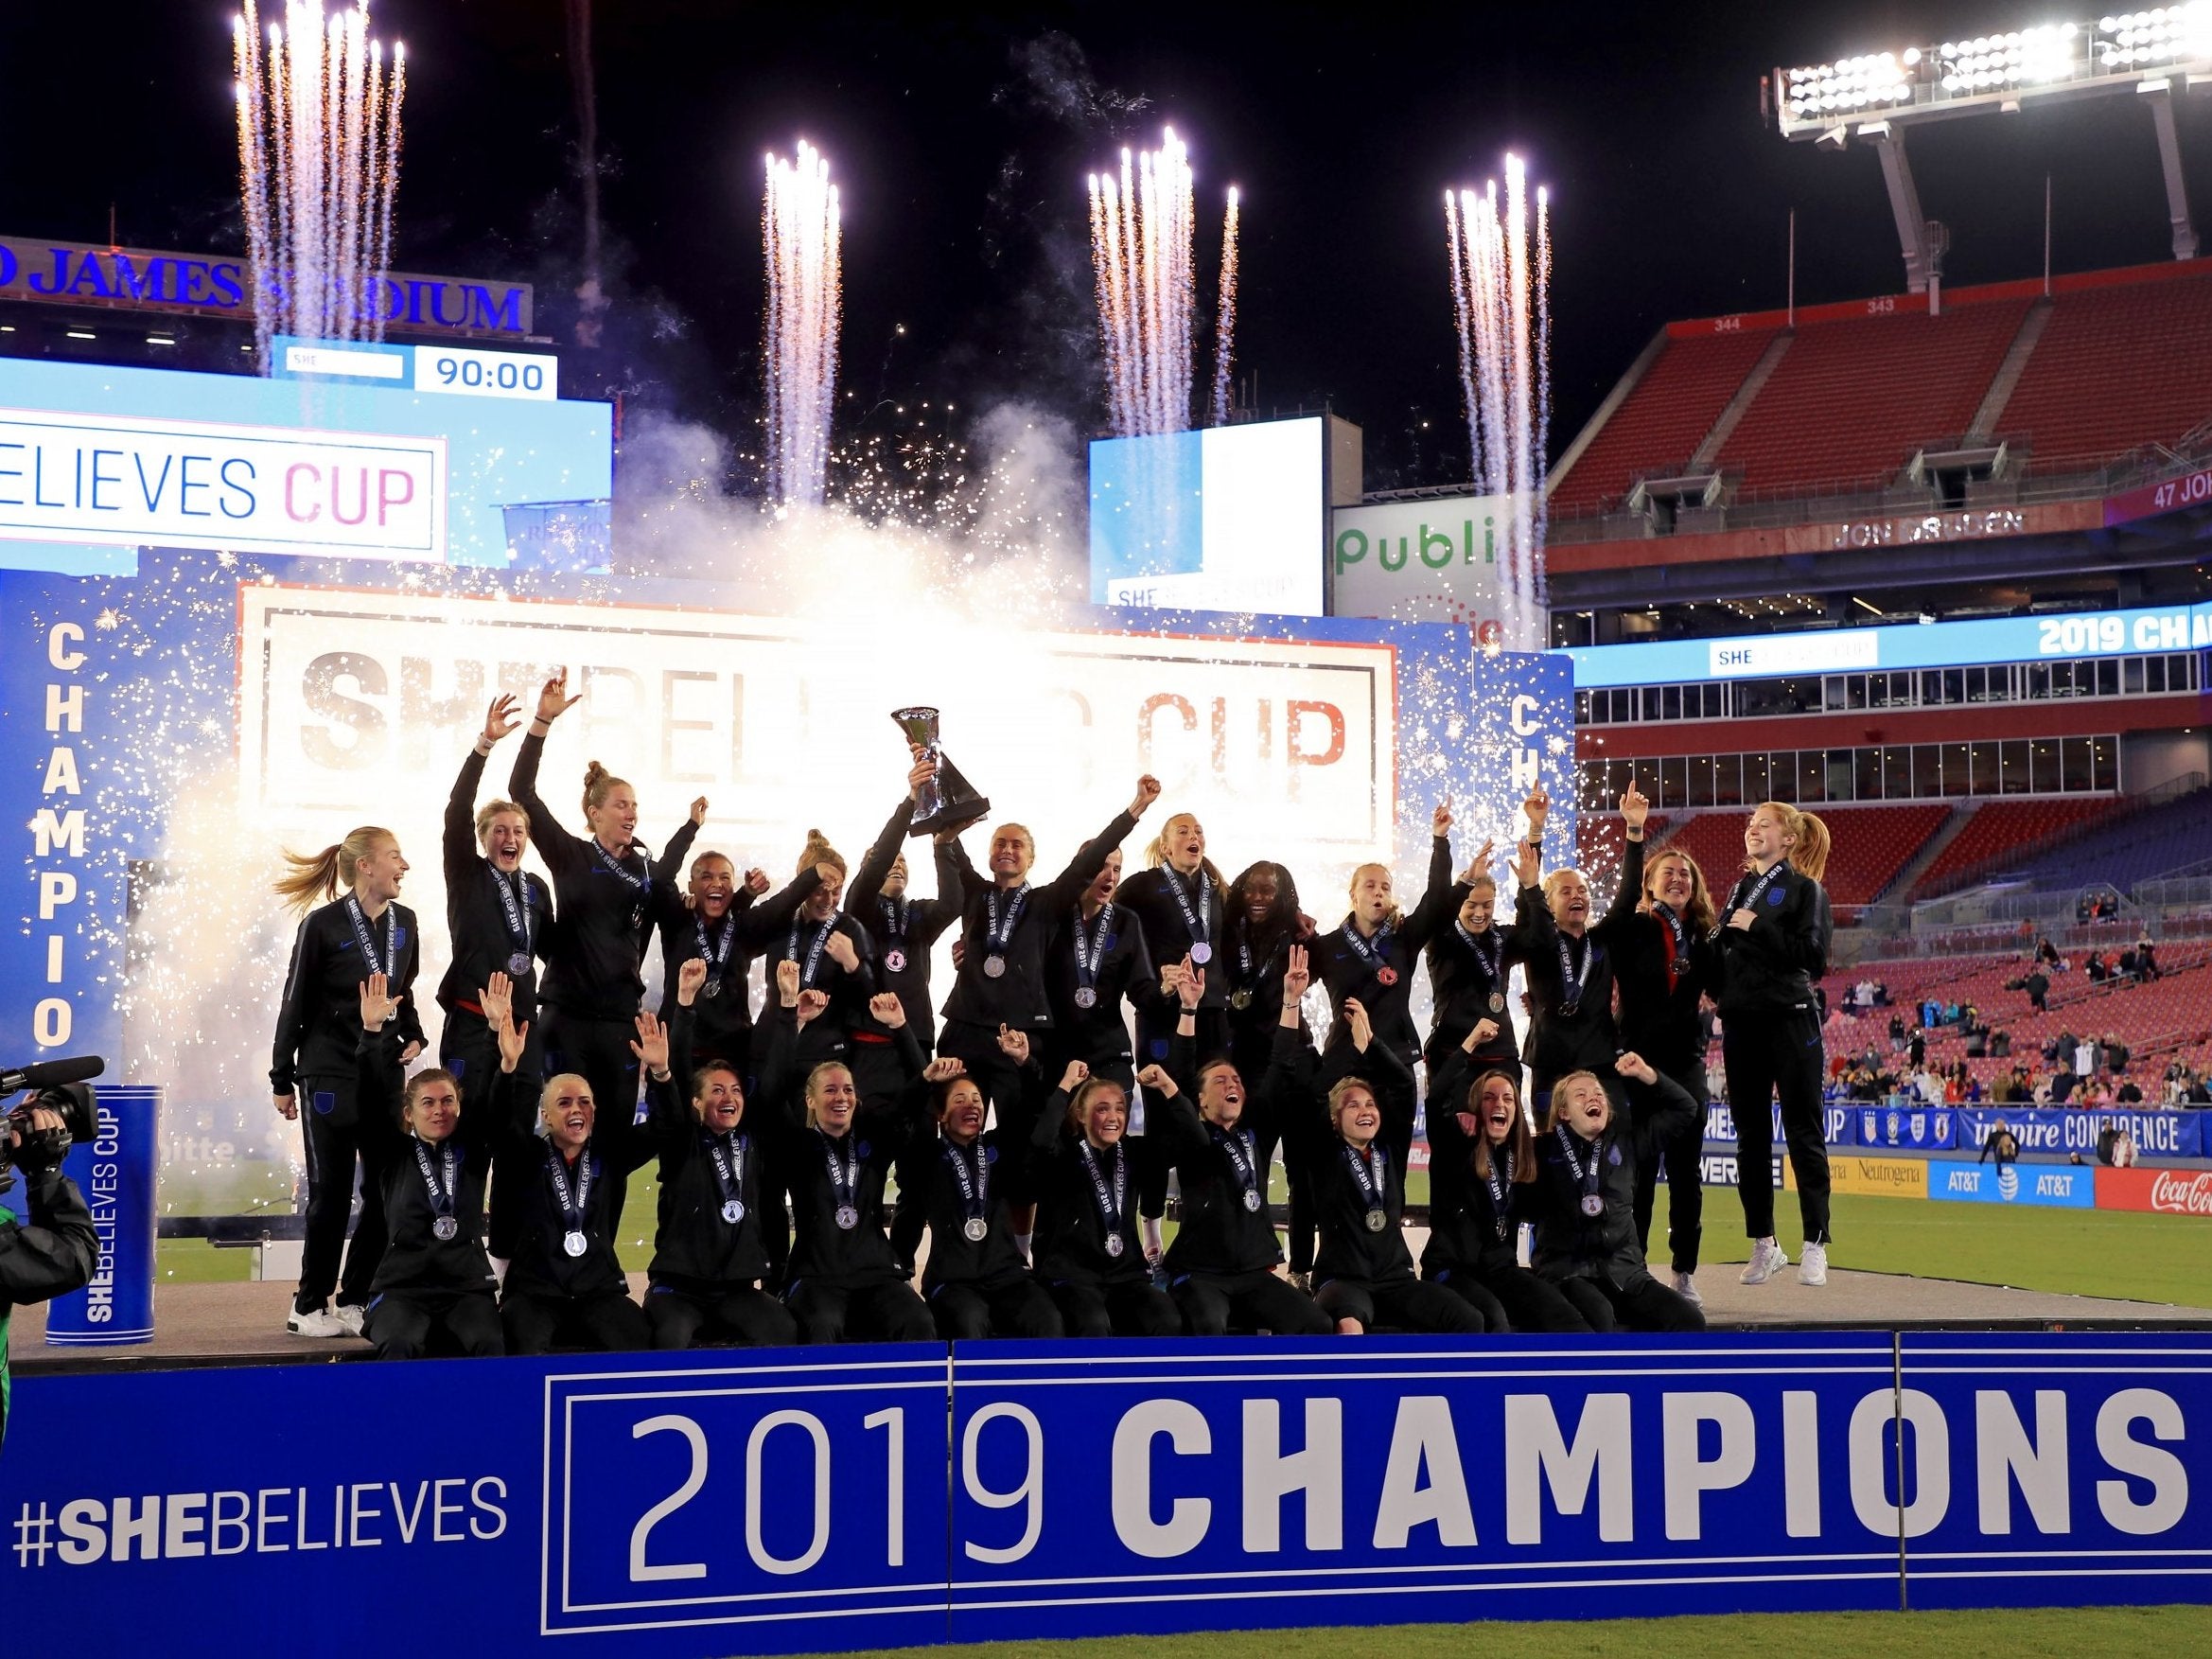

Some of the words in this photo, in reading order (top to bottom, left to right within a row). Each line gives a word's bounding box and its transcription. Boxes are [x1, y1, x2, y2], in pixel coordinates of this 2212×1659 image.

[28, 248, 244, 309] JAMES
[1868, 299, 1895, 314] 343
[1714, 317, 1741, 331] 344
[436, 357, 544, 392] 90:00
[284, 461, 415, 526] CUP
[2154, 483, 2176, 508] 47
[1335, 517, 1495, 575] Publi
[2039, 616, 2125, 655] 2019
[615, 866, 628, 879] CUP
[1757, 876, 1769, 890] CUP
[1767, 865, 1782, 879] 2019
[1012, 892, 1024, 906] CUP
[1177, 894, 1188, 909] CUP
[1183, 907, 1196, 925] 2019
[509, 911, 520, 932] 2019
[887, 906, 895, 922] CUP
[1103, 903, 1114, 920] 2019
[819, 927, 829, 943] CUP
[887, 918, 897, 934] 2019
[989, 917, 997, 936] 2019
[1098, 918, 1109, 933] CUP
[1077, 938, 1085, 952] CUP
[1346, 931, 1358, 945] CUP
[1355, 942, 1368, 957] 2019
[363, 943, 375, 959] CUP
[369, 957, 380, 973] 201
[1079, 950, 1088, 968] 2019
[1482, 959, 1493, 977] 2019
[1561, 951, 1571, 966] CUP
[1565, 963, 1573, 982] 2019
[93, 1107, 120, 1156] CUP
[711, 1147, 722, 1162] CUP
[1224, 1141, 1236, 1157] CUP
[1231, 1154, 1247, 1173] 2019
[1566, 1149, 1577, 1163] CUP
[420, 1161, 431, 1177] CUP
[426, 1174, 440, 1196] 2019
[716, 1159, 730, 1180] 2019
[827, 1153, 836, 1167] CUP
[832, 1165, 843, 1186] 2019
[957, 1165, 967, 1182] CUP
[1351, 1158, 1363, 1174] CUP
[1359, 1172, 1372, 1191] 2019
[1571, 1159, 1584, 1179] 2019
[1858, 1158, 1922, 1187] Neutrogena
[554, 1175, 566, 1191] CUP
[577, 1161, 591, 1209] SHEBELIEVES
[961, 1179, 974, 1200] 2019
[1095, 1178, 1106, 1193] CUP
[1491, 1180, 1502, 1201] 2019
[1948, 1171, 1982, 1193] AT&T
[2036, 1174, 2075, 1197] AT&T
[559, 1189, 571, 1211] 2019
[1099, 1191, 1113, 1214] 2019
[86, 1161, 118, 1323] SHEBELIEVES
[628, 1401, 1045, 1582] 2019
[1111, 1387, 2190, 1559] CHAMPIONS
[11, 1475, 509, 1568] #SHEBELIEVES
